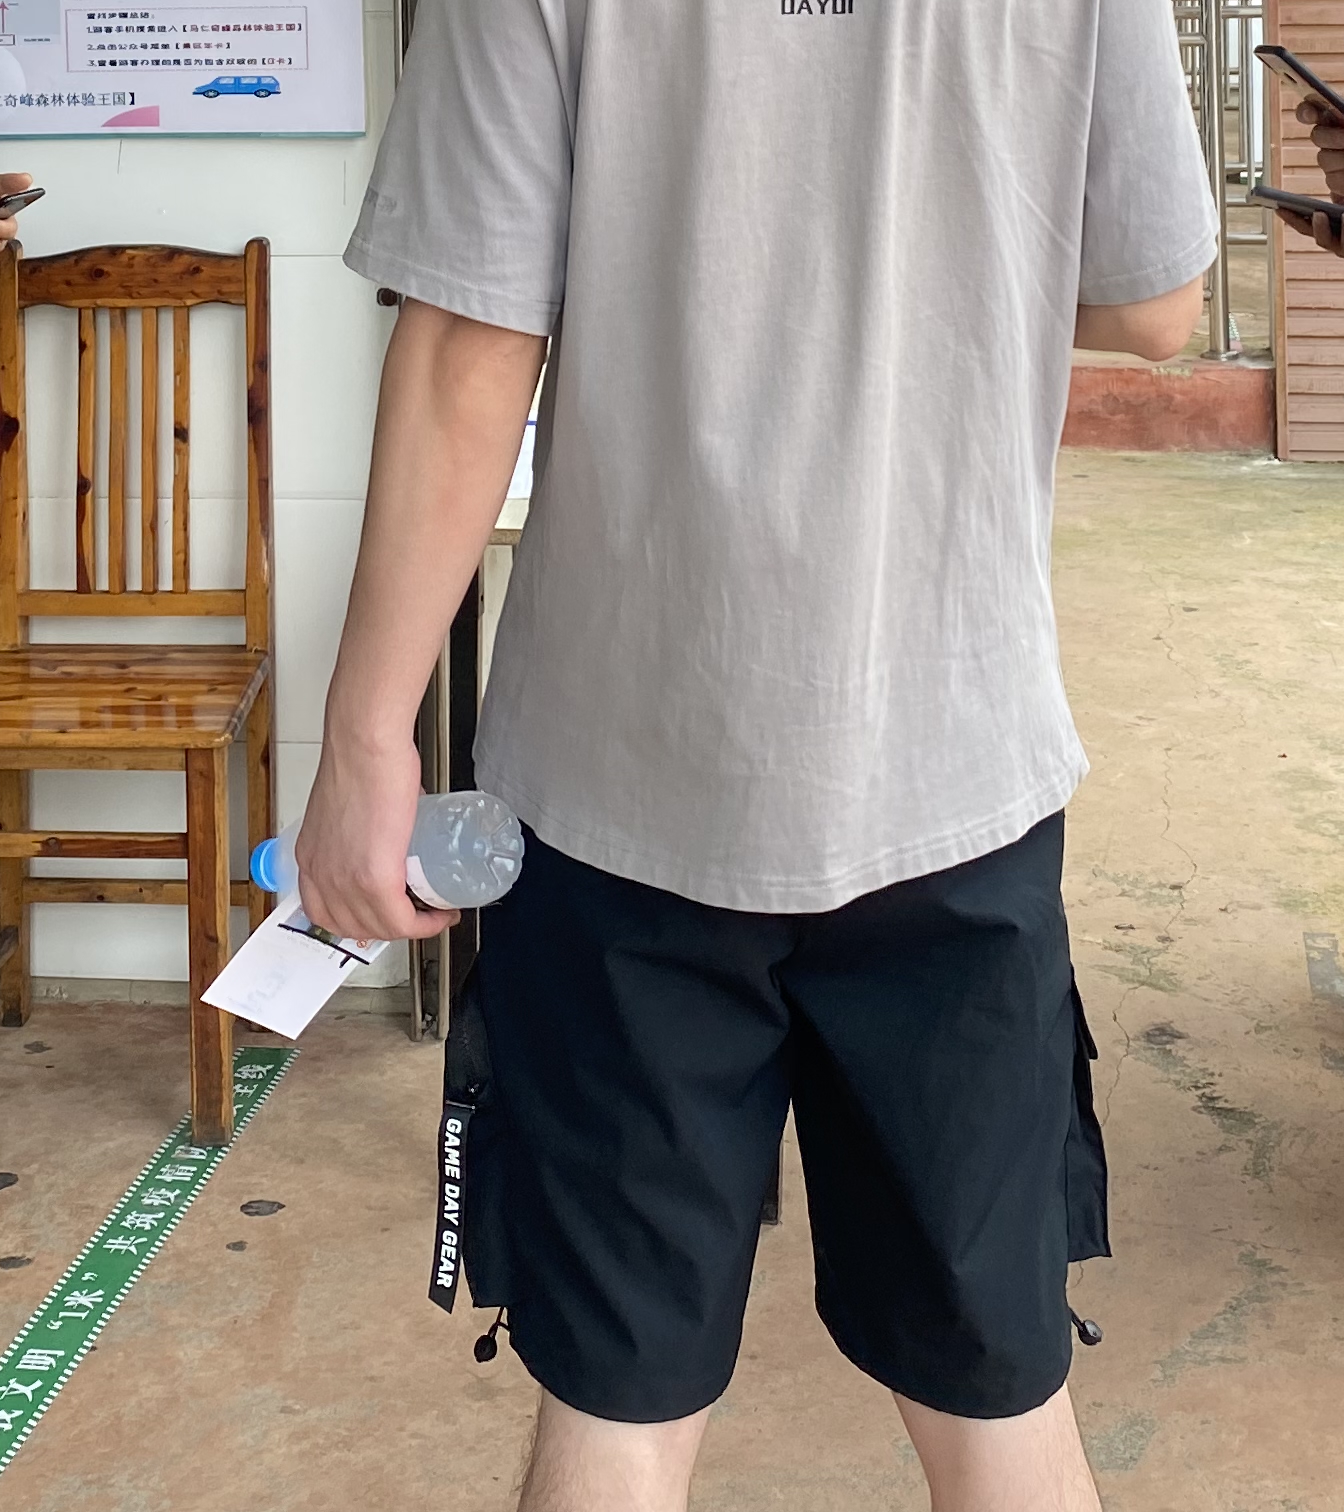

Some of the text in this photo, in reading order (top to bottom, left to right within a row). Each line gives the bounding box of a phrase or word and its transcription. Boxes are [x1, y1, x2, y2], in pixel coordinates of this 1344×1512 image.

[436, 1117, 462, 1288] GAME DAY GEAR
